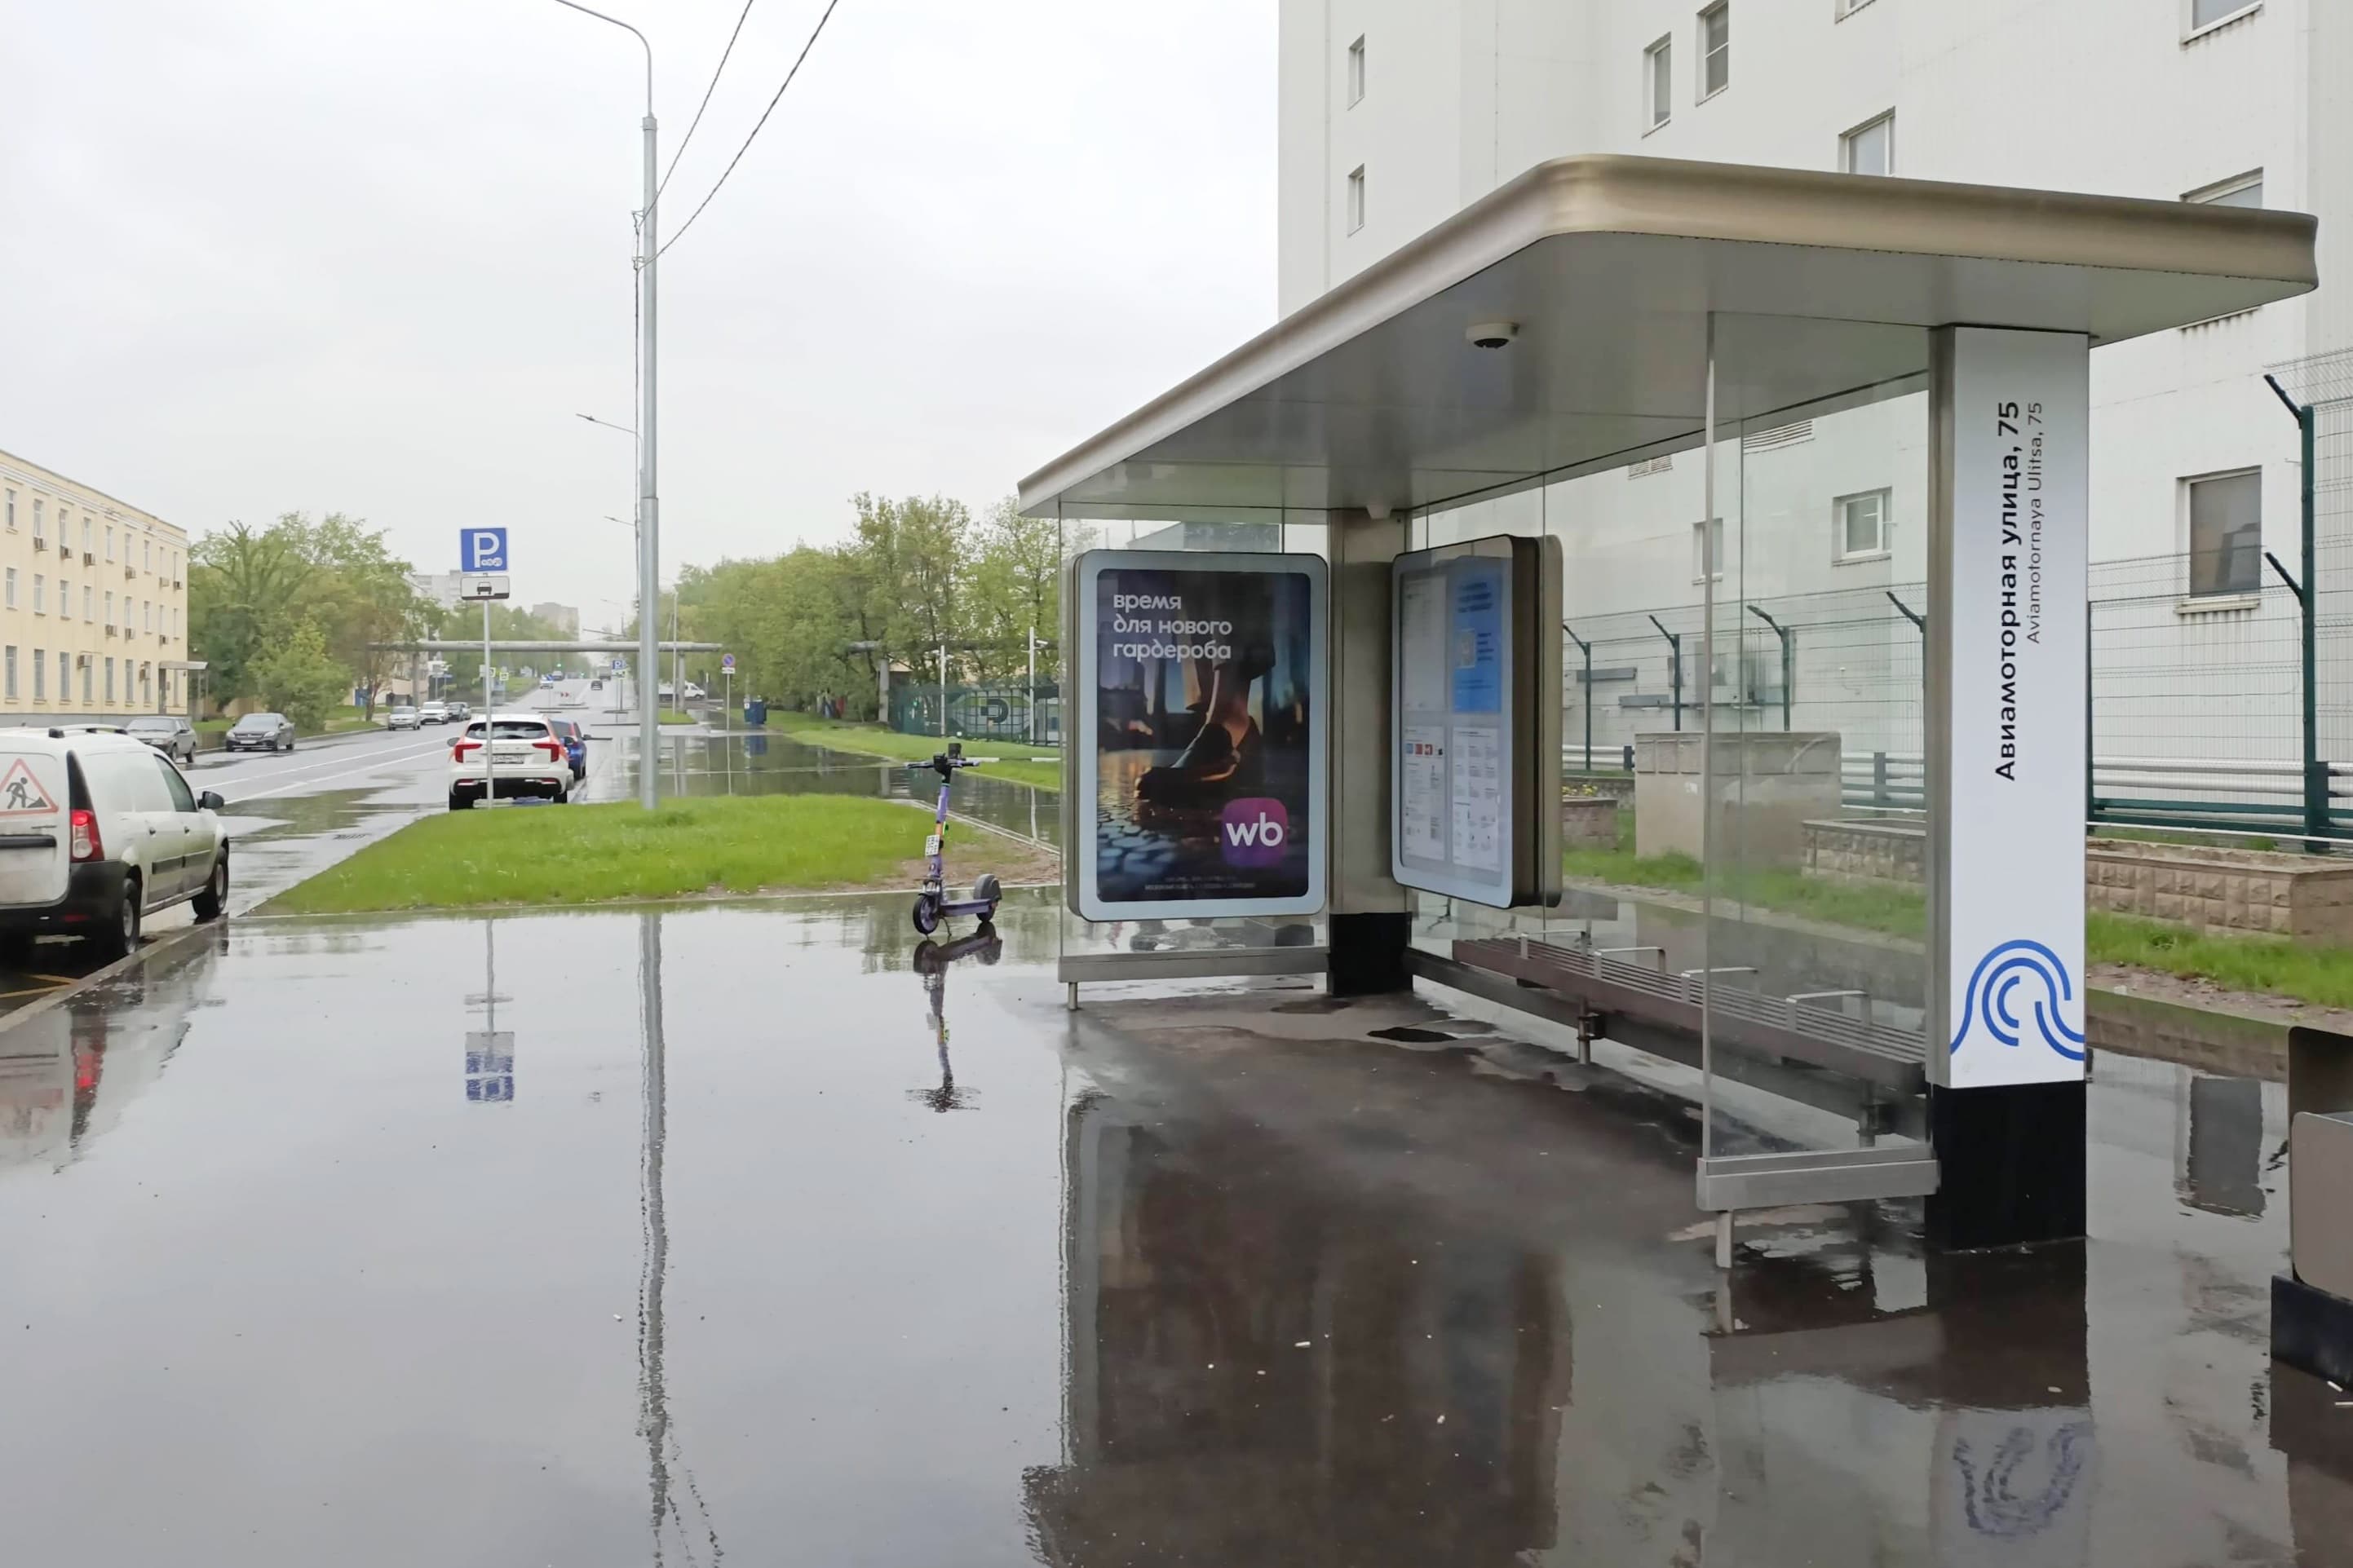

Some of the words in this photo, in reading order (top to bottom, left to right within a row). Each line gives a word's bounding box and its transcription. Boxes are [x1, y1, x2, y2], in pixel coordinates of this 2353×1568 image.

[1997, 402, 2019, 437] 75
[2028, 402, 2042, 425] 75
[2027, 431, 2044, 491] Ulitsa,
[2001, 446, 2023, 545] улица,
[473, 532, 500, 568] P
[2027, 499, 2045, 644] Aviamotornaya
[1112, 594, 1182, 613] время
[1112, 613, 1152, 634] для
[1158, 620, 1233, 635] нового
[1112, 638, 1232, 663] гардероба
[1995, 555, 2021, 783] Авиамоторная
[1225, 811, 1284, 846] wb
